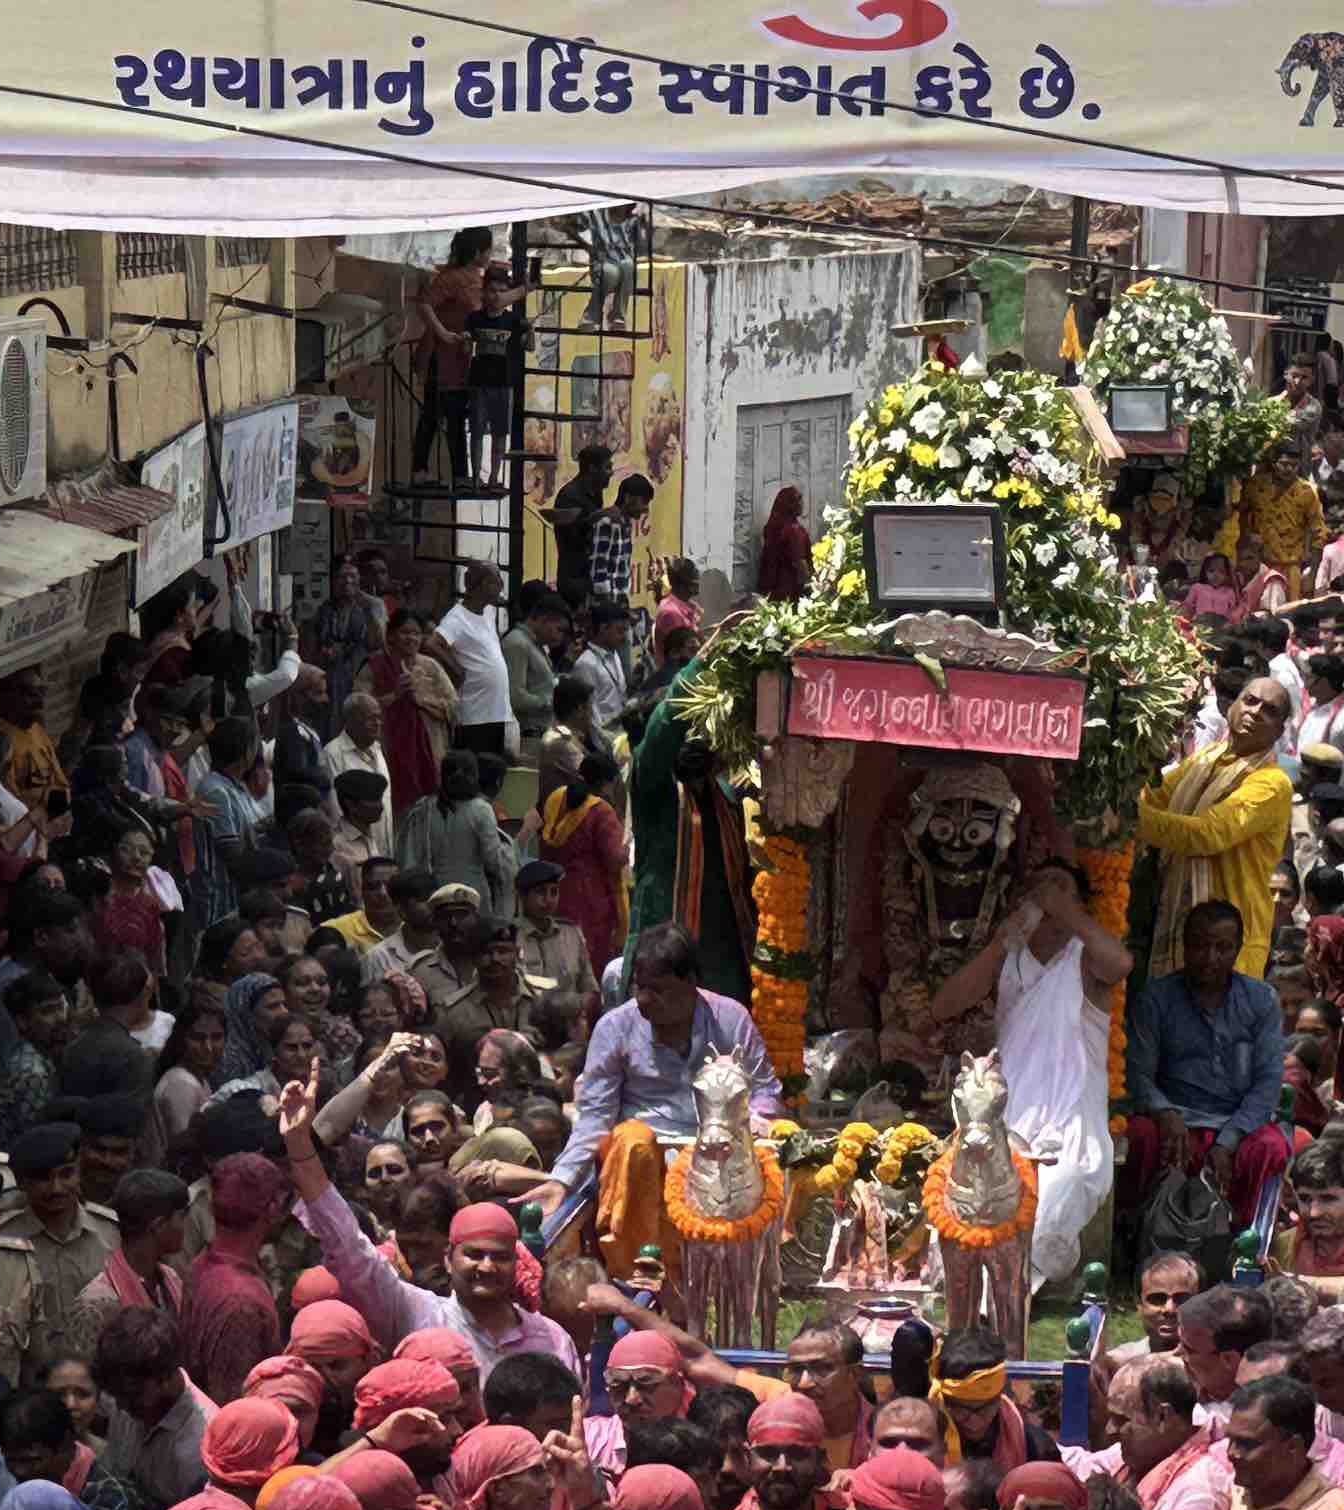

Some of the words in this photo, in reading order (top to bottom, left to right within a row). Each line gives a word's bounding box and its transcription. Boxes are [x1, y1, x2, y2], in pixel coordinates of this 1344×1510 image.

[113, 36, 434, 136] રથયાત્રાનું
[457, 36, 633, 116] હાર્દિક
[657, 62, 887, 116] સ્વાગત
[914, 44, 993, 119] કરે
[1018, 44, 1102, 120] છે.
